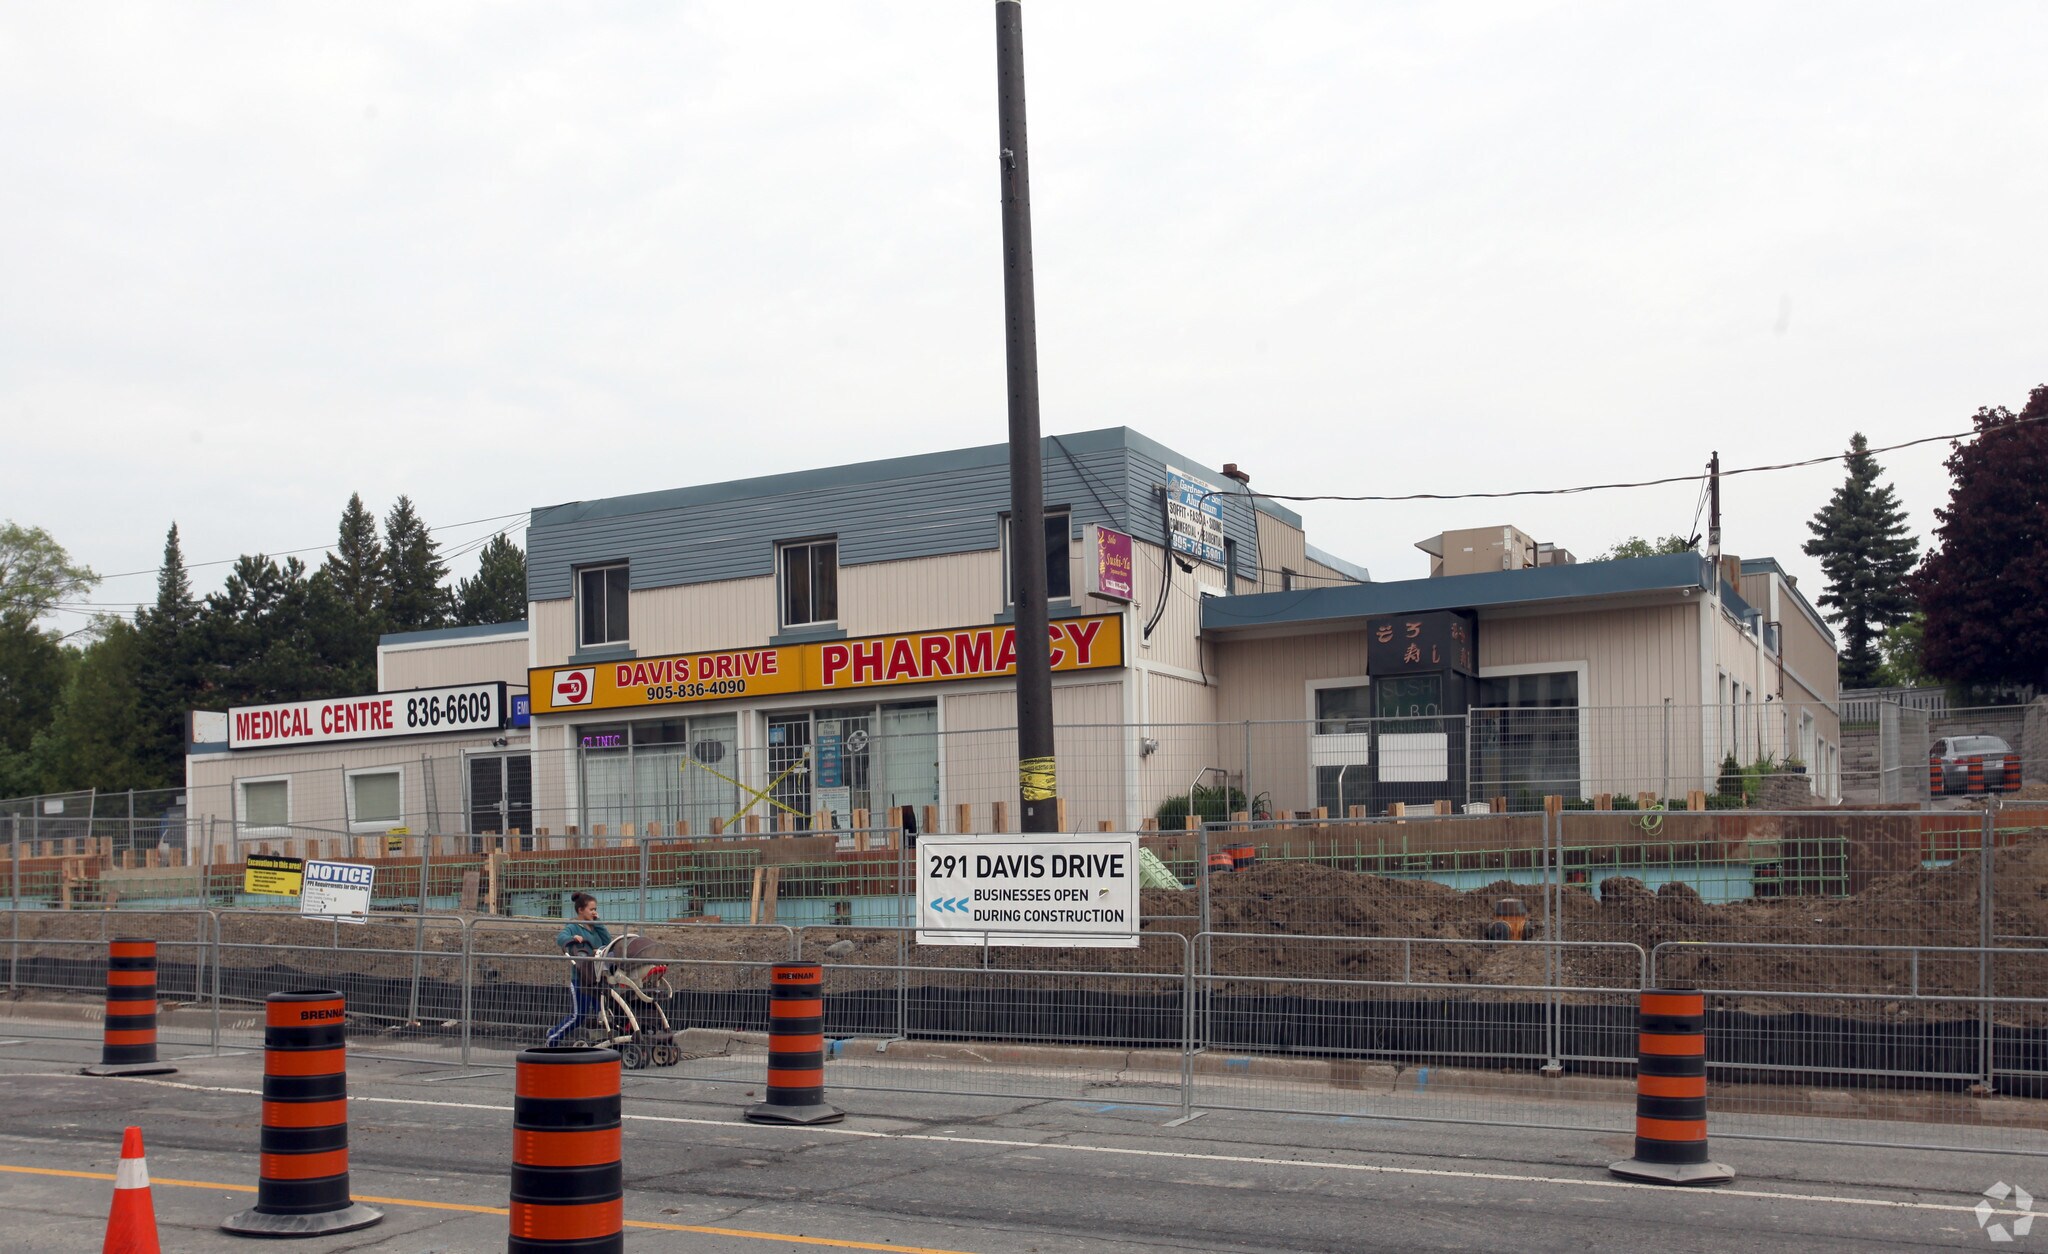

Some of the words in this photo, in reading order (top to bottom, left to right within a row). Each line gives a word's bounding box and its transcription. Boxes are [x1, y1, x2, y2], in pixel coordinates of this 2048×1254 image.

[1169, 501, 1187, 519] SOFFIT
[616, 659, 690, 689] DAVIS
[698, 650, 778, 681] DRIVE
[646, 679, 746, 702] 905-836-4090
[236, 706, 313, 741] MEDICAL
[320, 699, 394, 735] CENTRE
[406, 691, 491, 729] 836-6609
[582, 734, 621, 749] CLINIC
[306, 864, 371, 884] NOTICE
[930, 855, 968, 879] 291
[976, 854, 1045, 879] DAVIS
[1052, 854, 1124, 879] DRIVE
[974, 889, 1051, 902] BUSINESSES
[1054, 889, 1089, 902] OPEN
[974, 909, 1021, 922] DURING
[1024, 909, 1124, 923] CONSTRUCTION
[777, 972, 815, 981] BRENNAN
